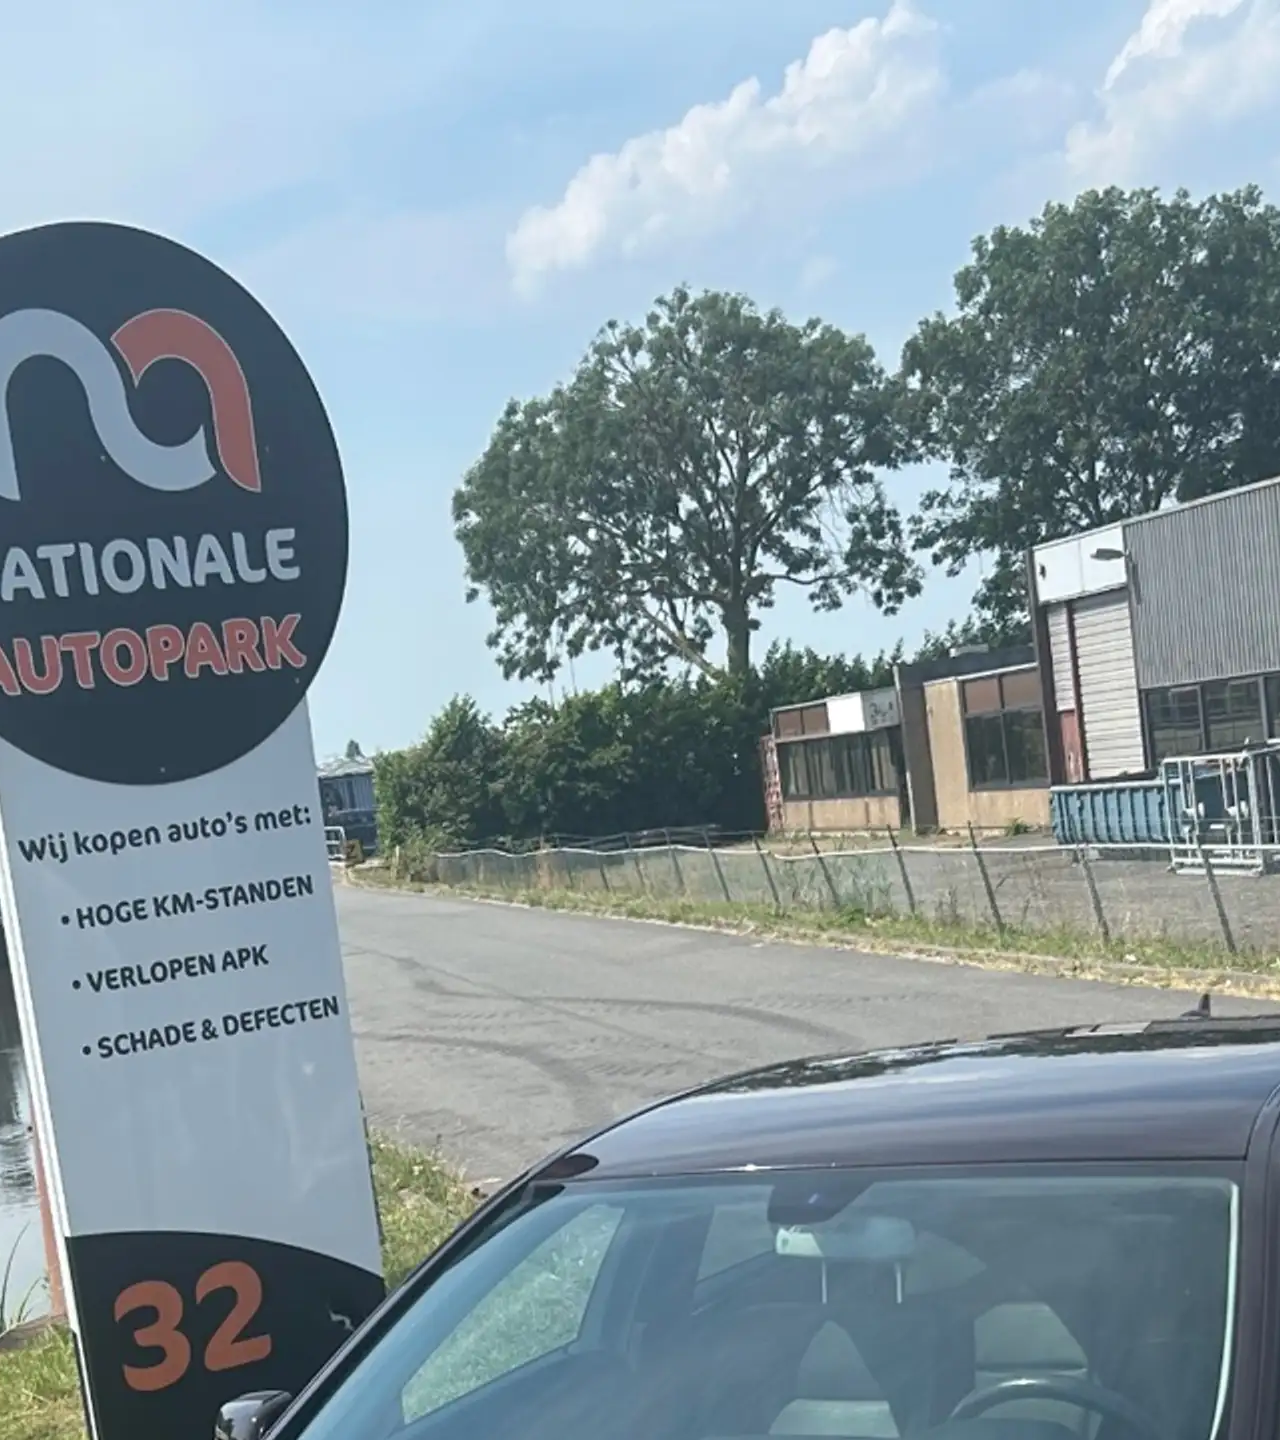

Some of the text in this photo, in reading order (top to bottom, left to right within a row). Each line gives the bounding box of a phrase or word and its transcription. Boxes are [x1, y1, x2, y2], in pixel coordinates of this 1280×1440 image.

[17, 833, 69, 864] Wij
[73, 823, 161, 857] kopen
[254, 803, 312, 833] met:
[76, 875, 314, 930] HOGE KM-STANDEN
[87, 944, 269, 993] VERLOPEN APK
[97, 995, 340, 1059] SCHADE & DEFECTEN
[113, 1260, 273, 1392] 32
